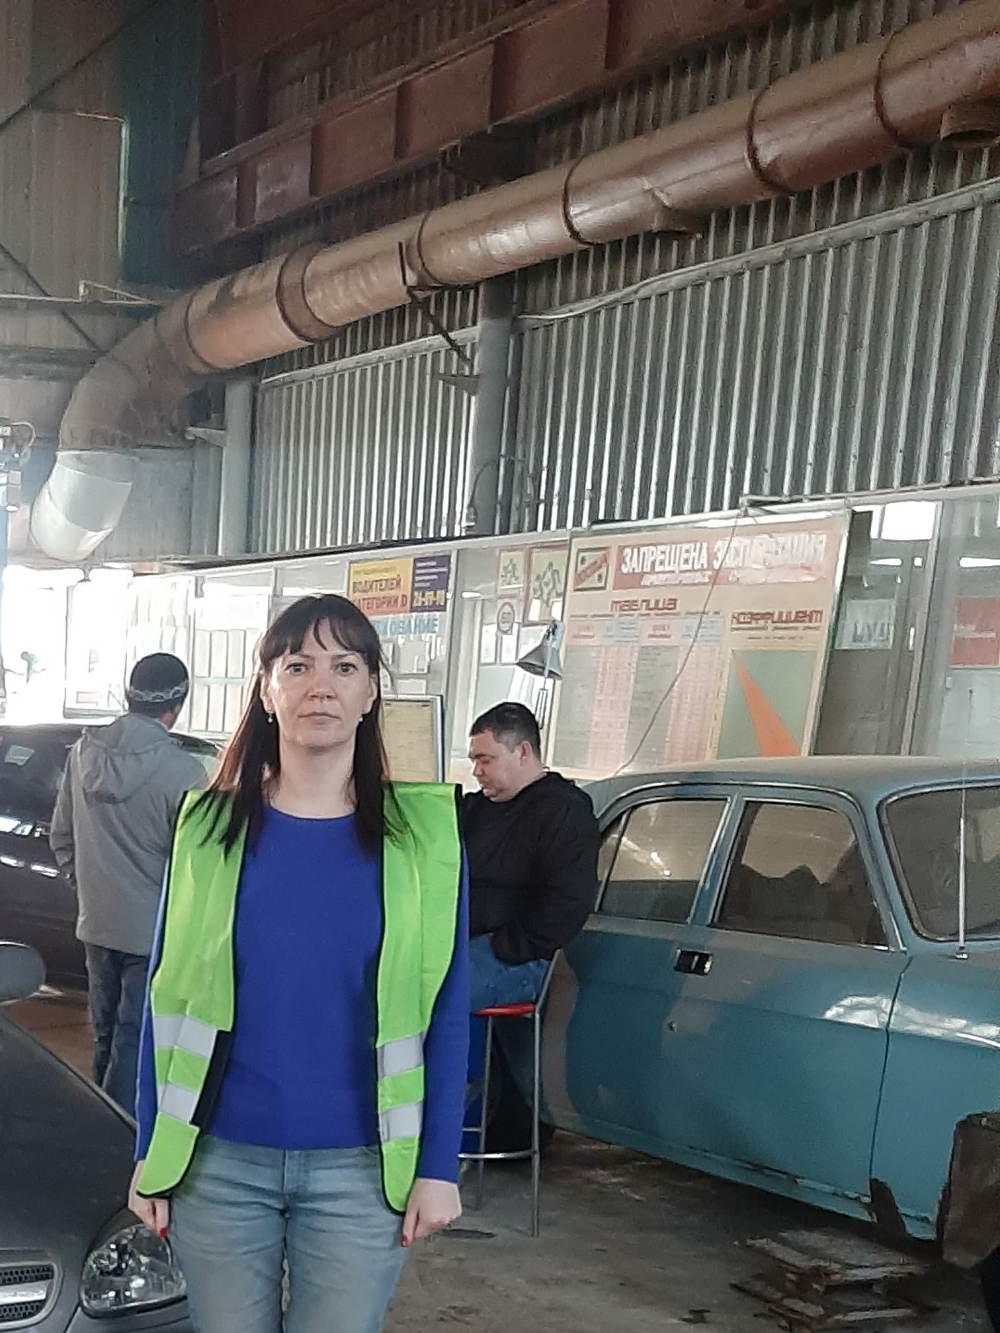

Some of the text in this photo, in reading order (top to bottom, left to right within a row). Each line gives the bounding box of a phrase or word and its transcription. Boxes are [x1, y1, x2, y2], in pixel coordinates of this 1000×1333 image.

[621, 542, 708, 574] ЗАПРЕЩЕНА
[713, 533, 827, 570] ЭКСПАЦИЯ
[356, 596, 399, 611] АТЕГОРИИ
